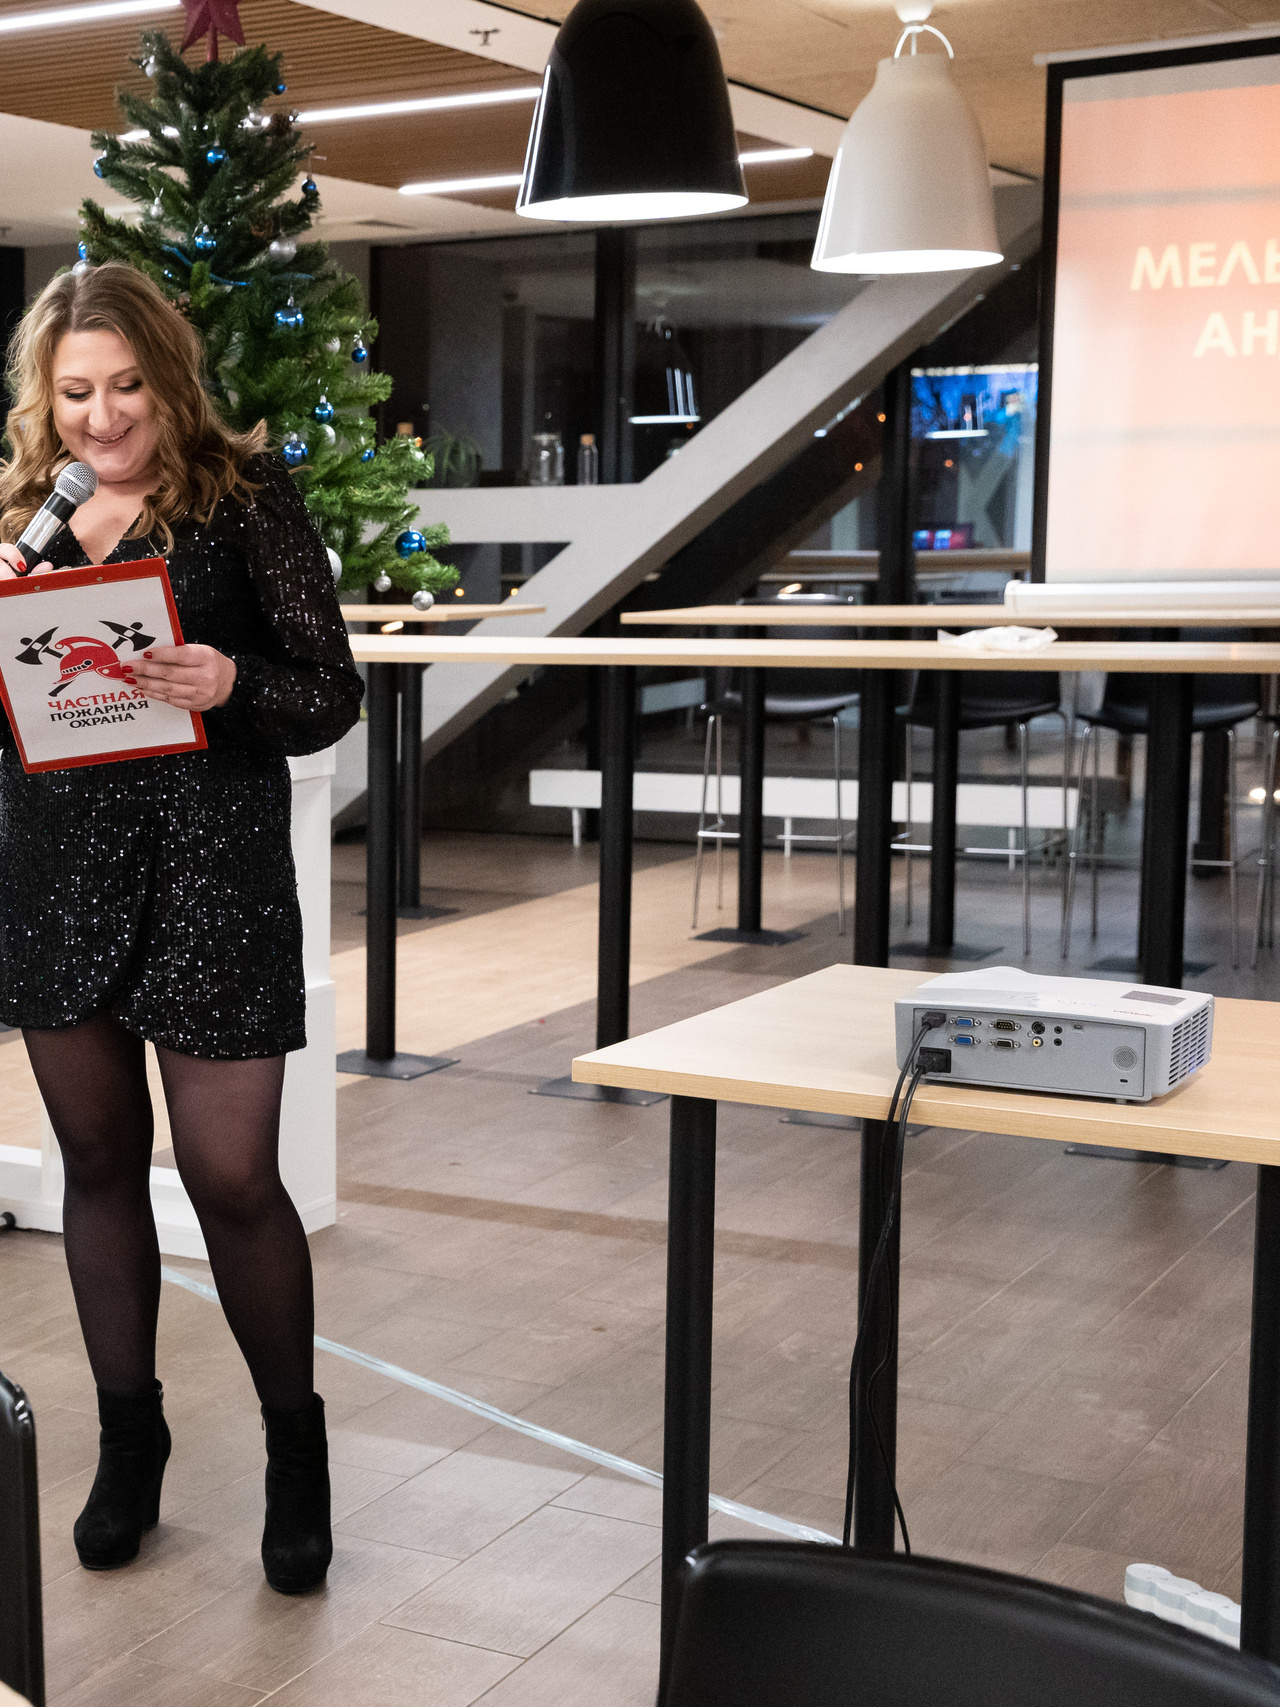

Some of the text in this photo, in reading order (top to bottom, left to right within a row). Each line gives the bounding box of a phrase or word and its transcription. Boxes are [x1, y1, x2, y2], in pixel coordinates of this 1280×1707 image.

[1193, 309, 1279, 358] АН
[48, 688, 146, 711] ЧАСТНАЯ
[50, 700, 149, 722] ПОЖАРНАЯ
[69, 713, 136, 729] ОХРАНА
